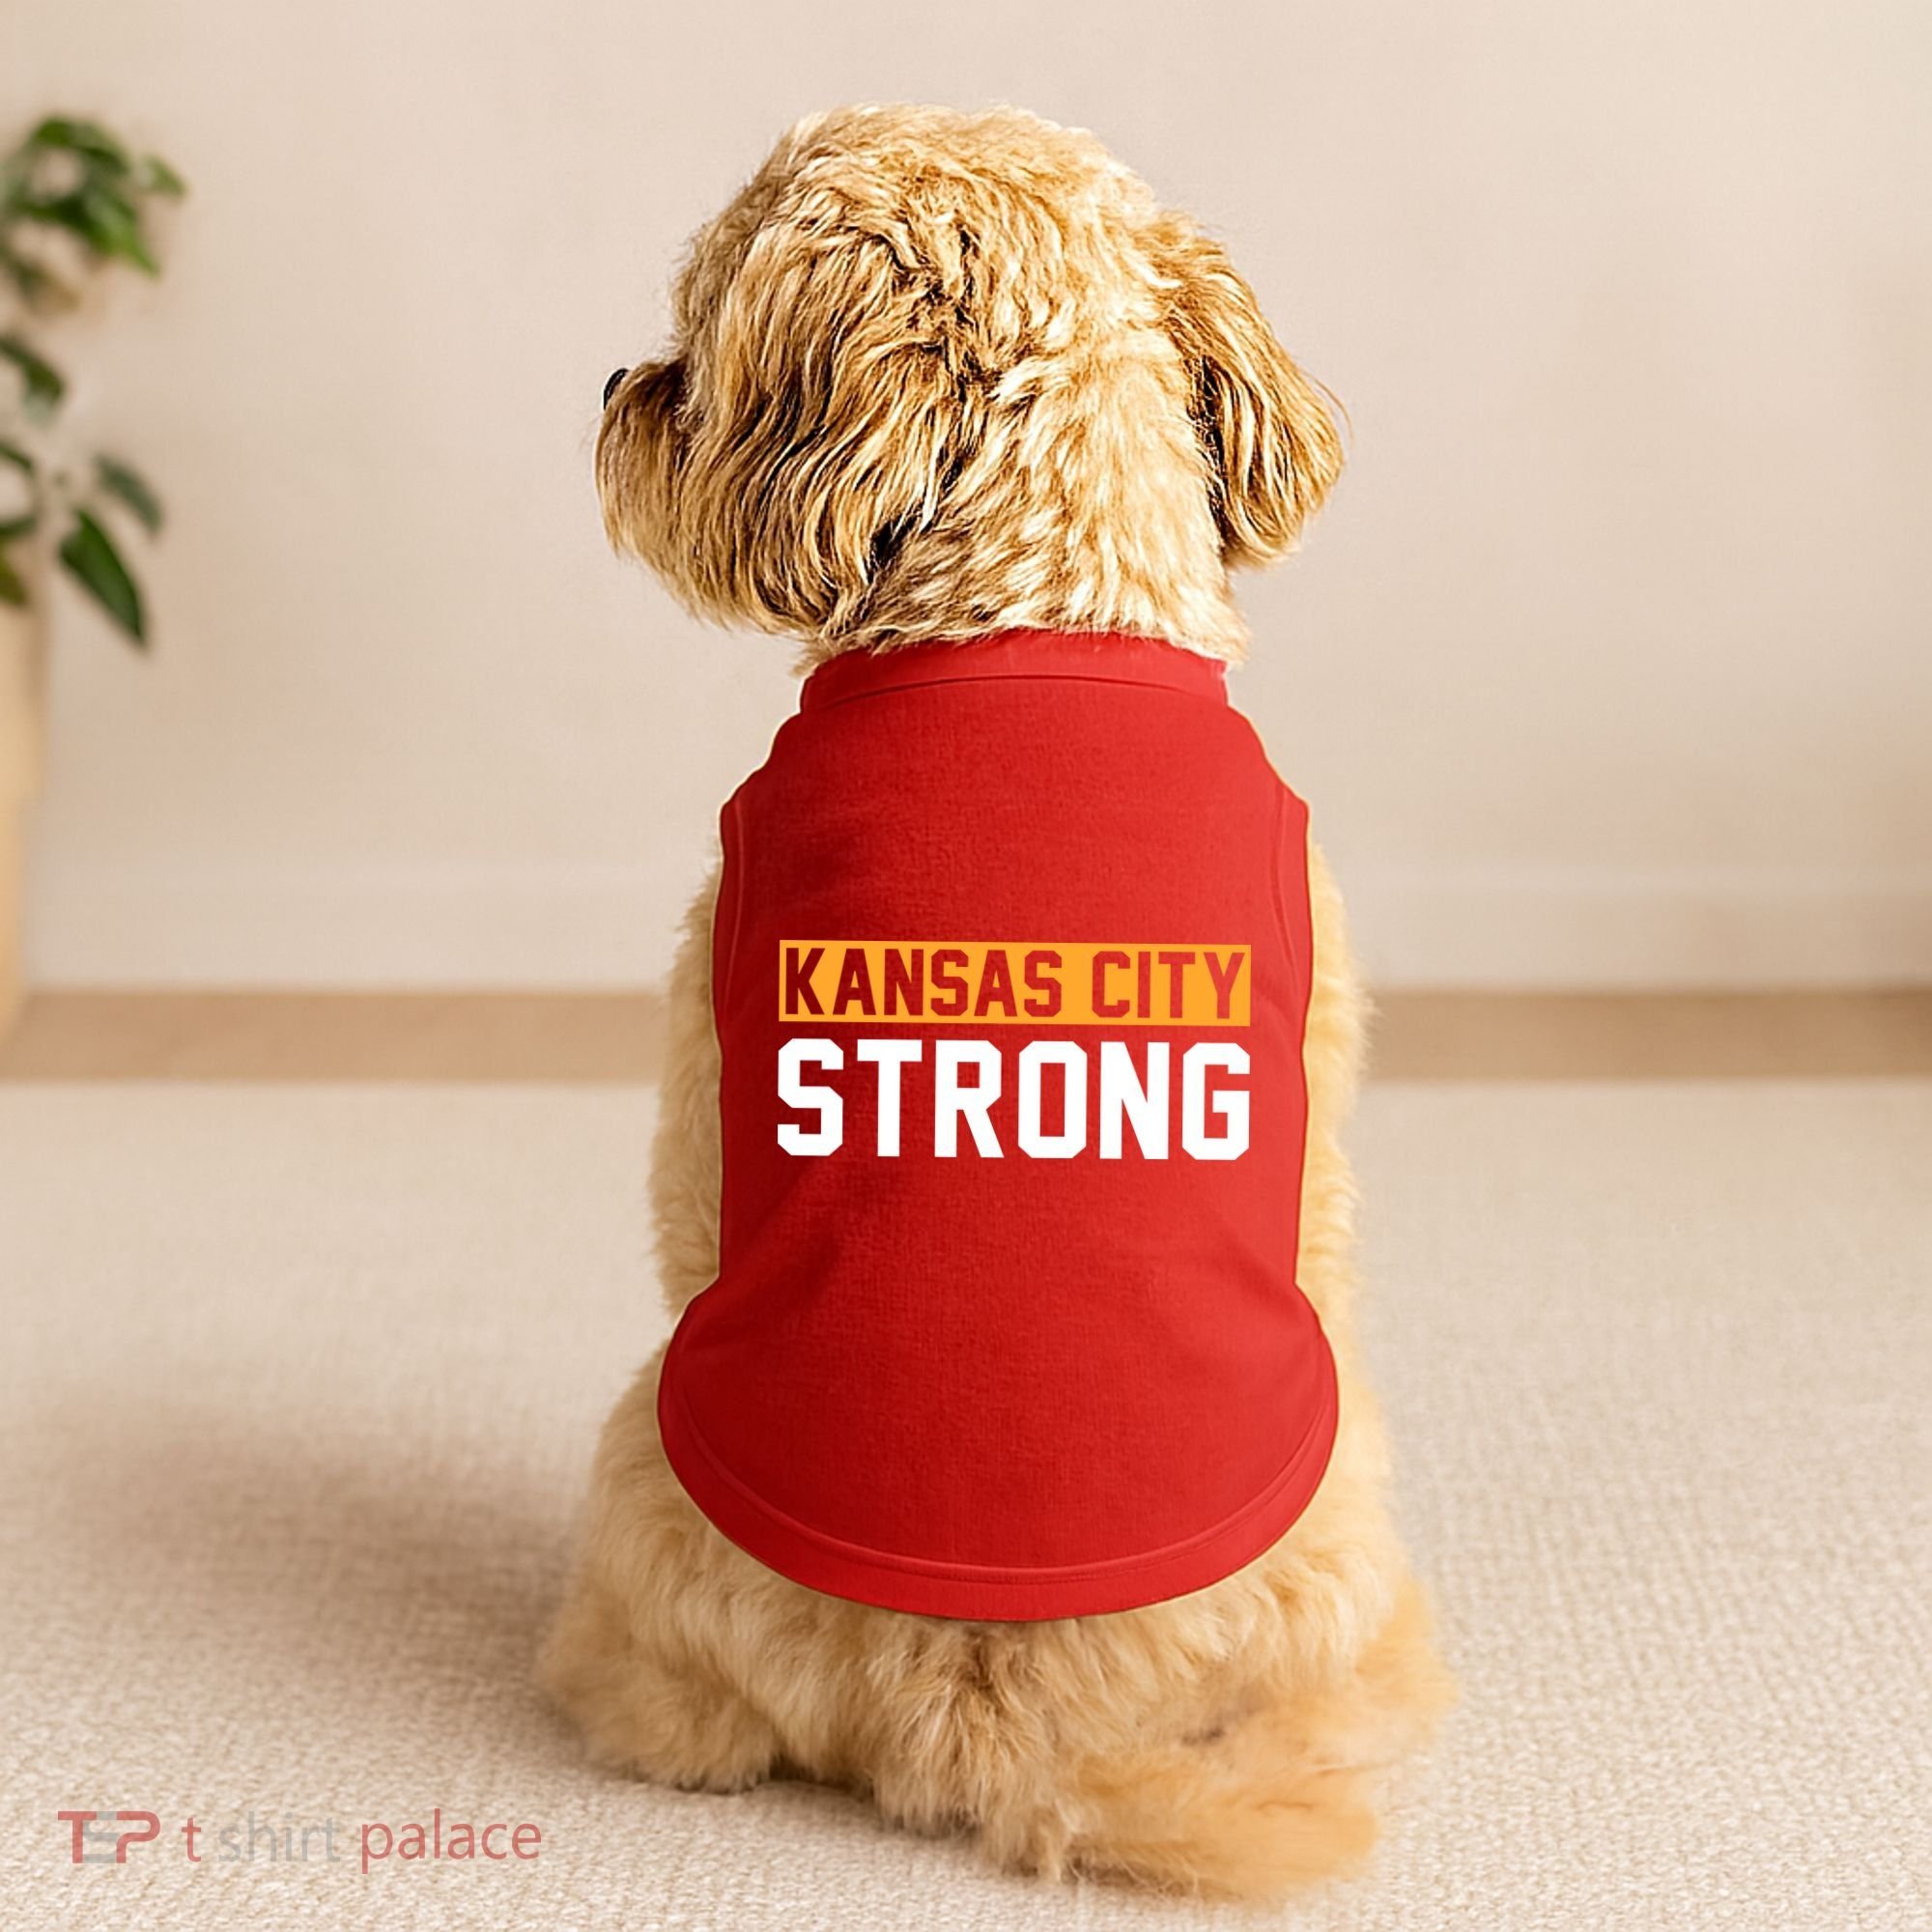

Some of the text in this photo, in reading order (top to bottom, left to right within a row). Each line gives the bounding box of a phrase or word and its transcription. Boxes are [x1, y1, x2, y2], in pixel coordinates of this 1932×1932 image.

[784, 947, 1245, 1019] KANSAS CITY
[777, 1037, 1251, 1161] STRONG
